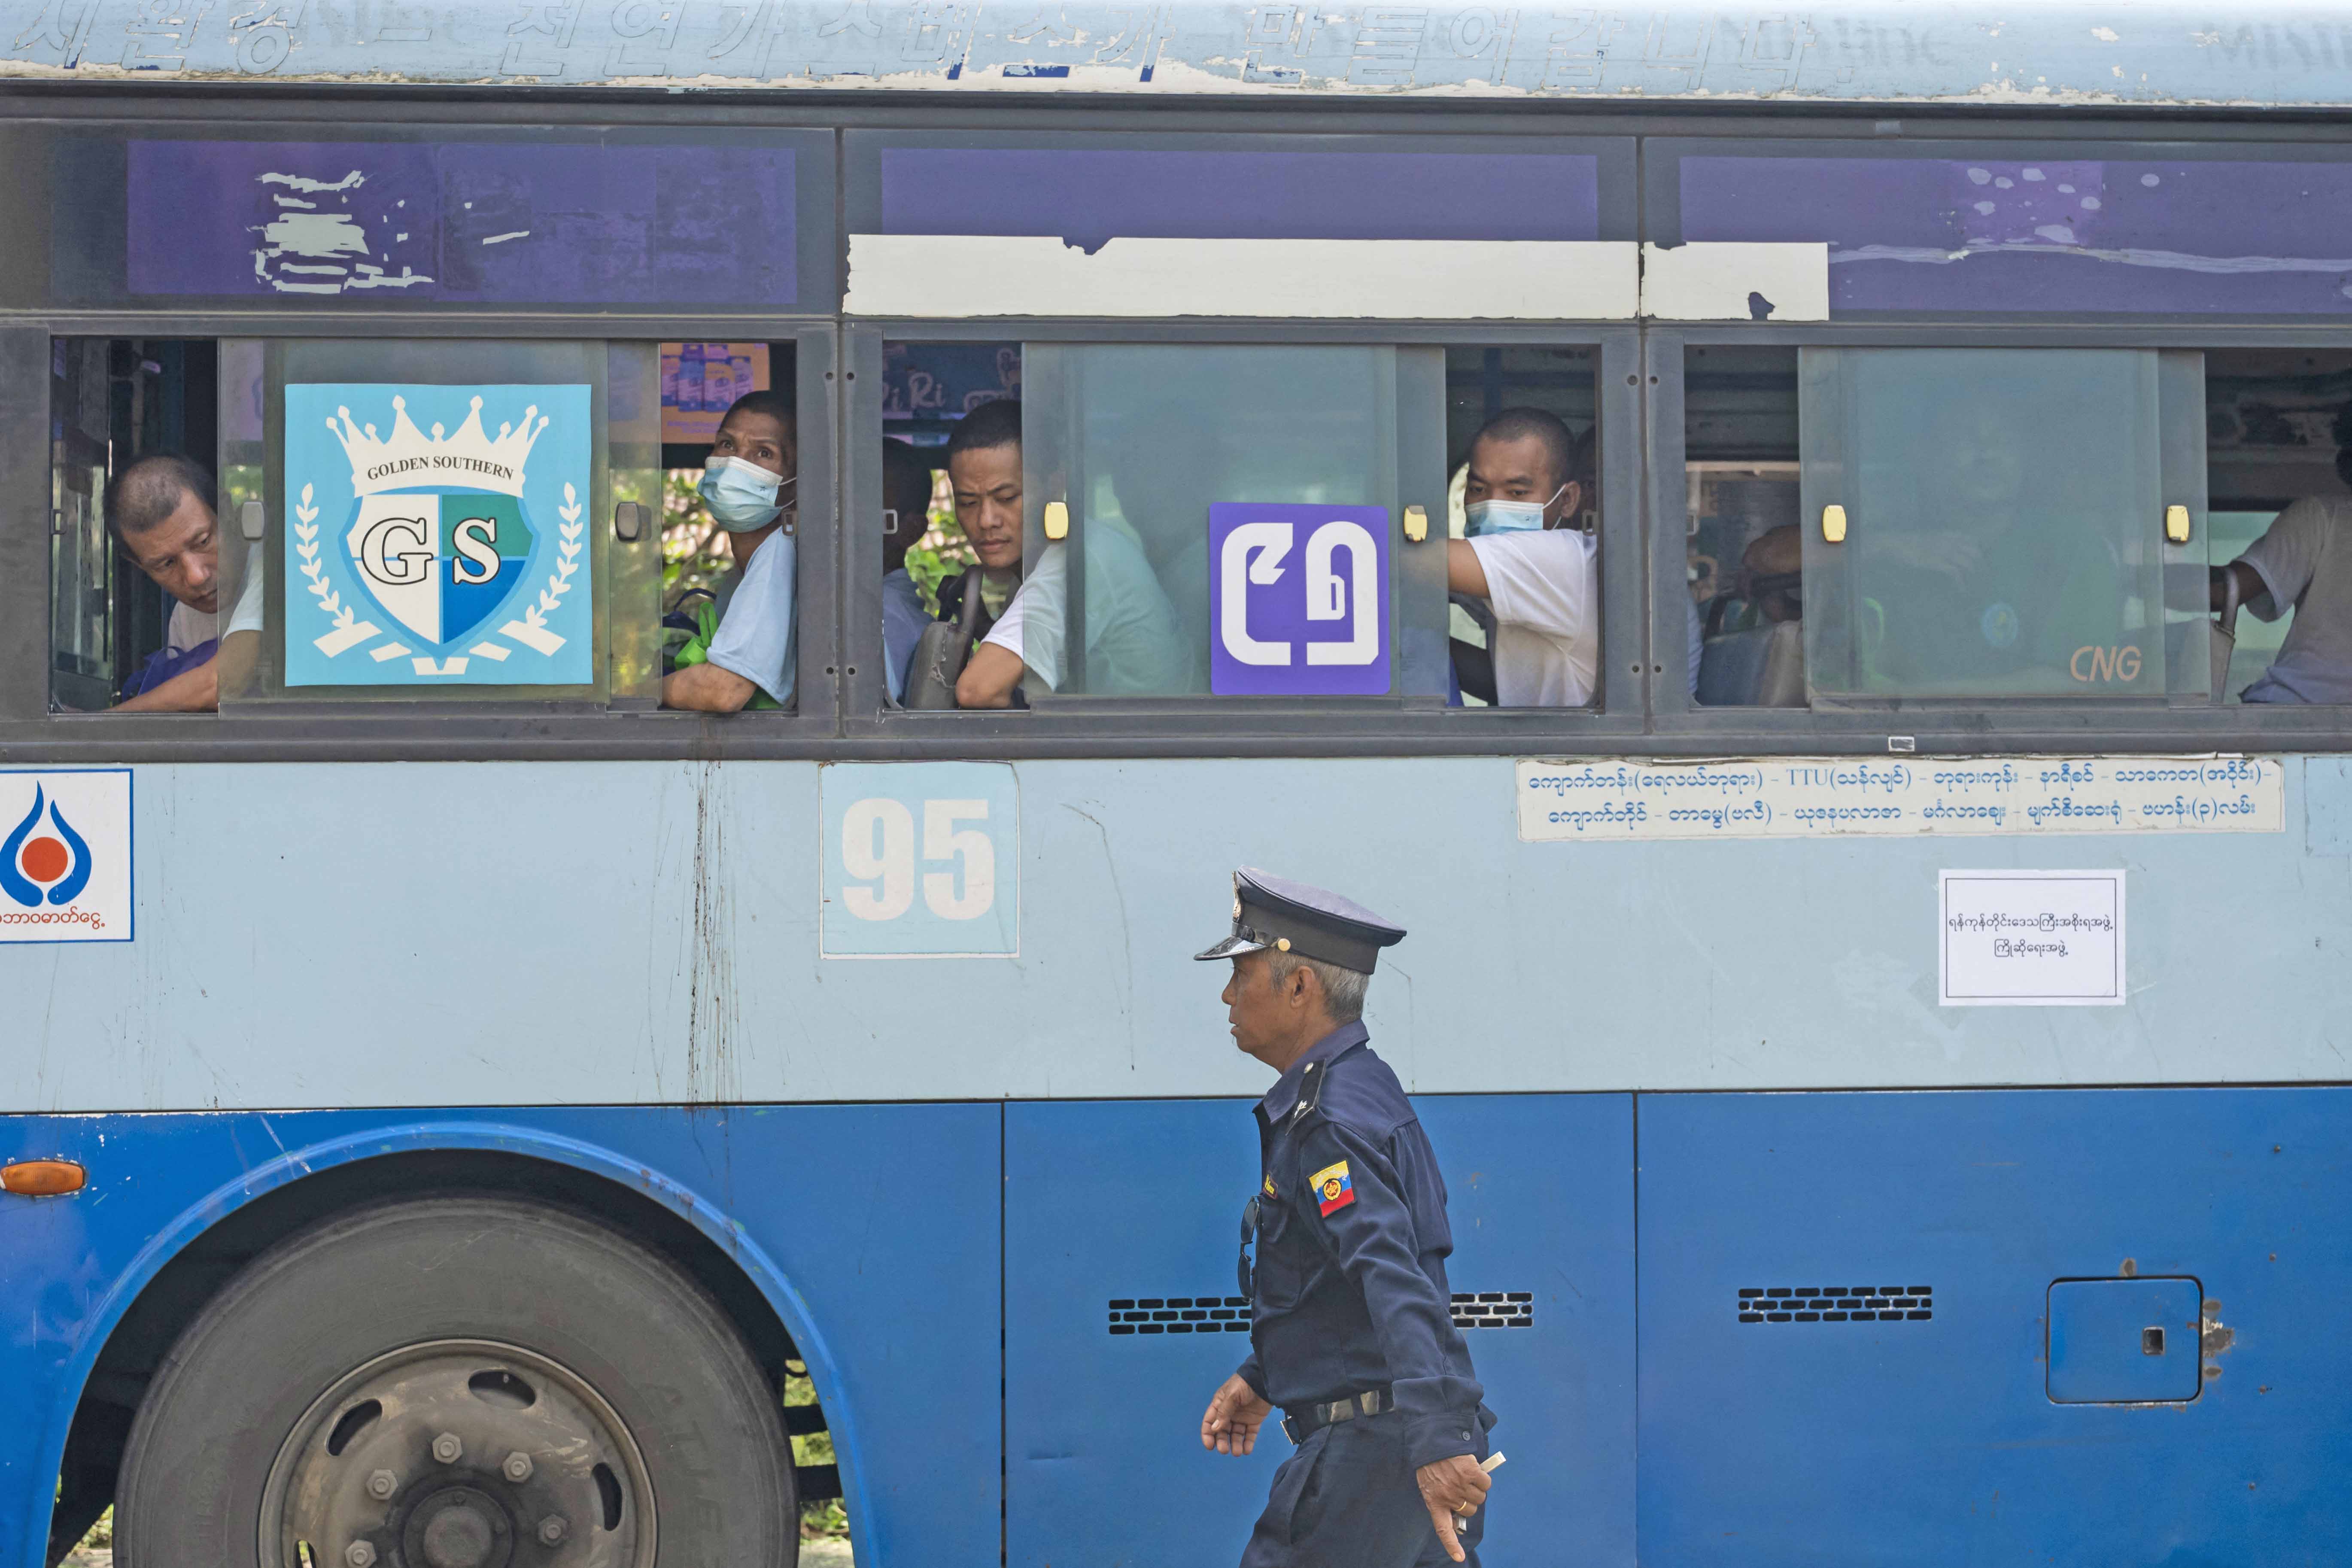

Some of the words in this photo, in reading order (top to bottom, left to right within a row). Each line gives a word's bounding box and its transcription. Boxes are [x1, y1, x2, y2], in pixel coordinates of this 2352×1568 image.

[368, 456, 429, 480] GOLDEN
[433, 456, 514, 480] SOUTHERN
[2070, 645, 2142, 682] CNG
[842, 798, 995, 921] 95
[0, 906, 106, 930] ဘာဝဓာတ်ငွေ့
